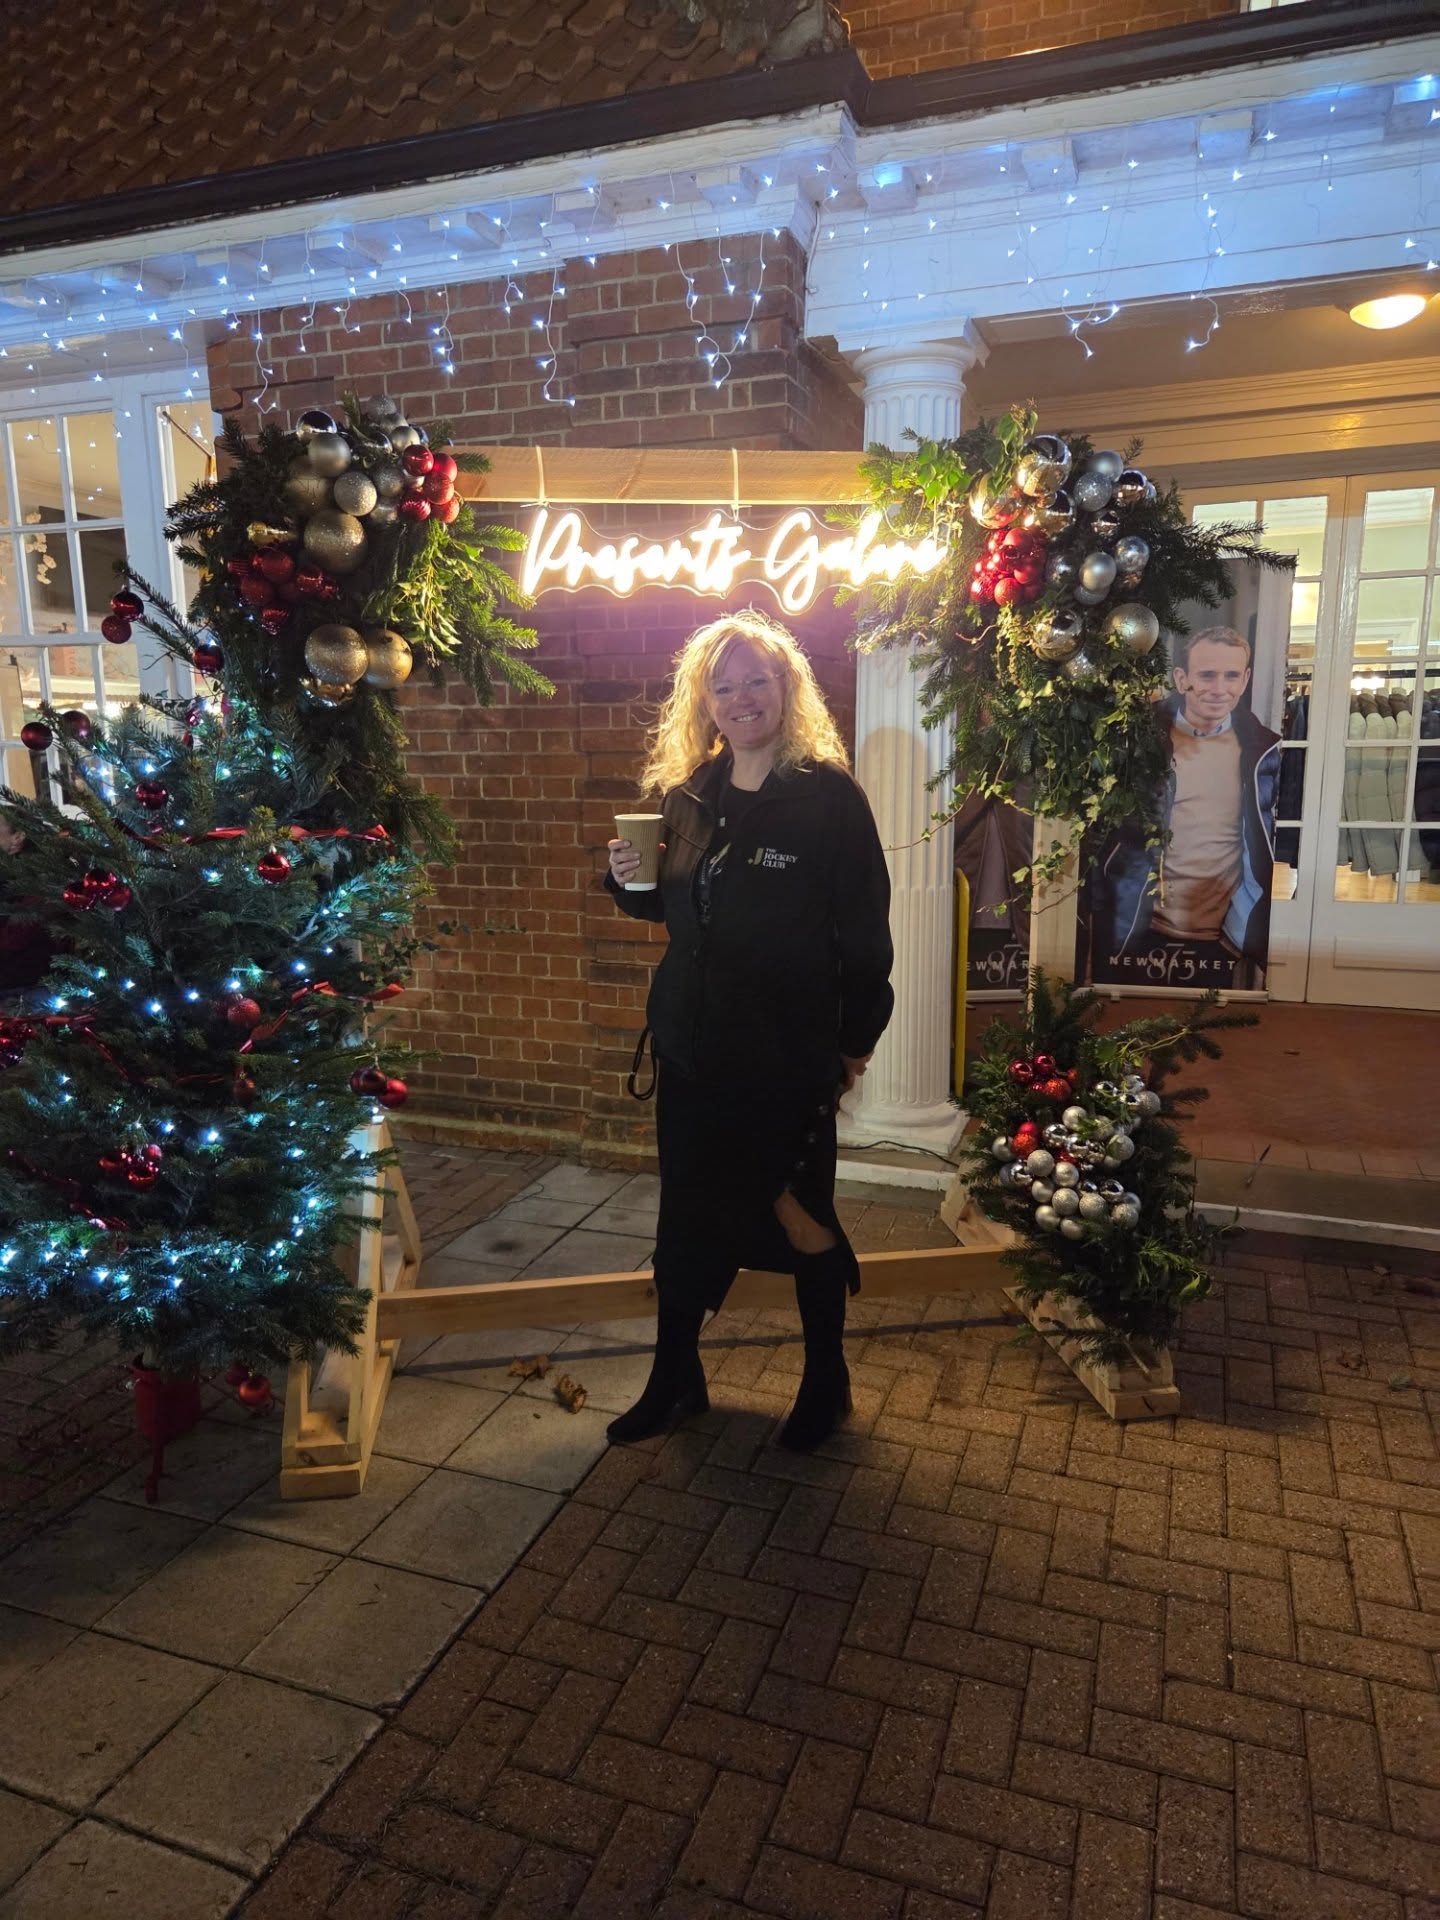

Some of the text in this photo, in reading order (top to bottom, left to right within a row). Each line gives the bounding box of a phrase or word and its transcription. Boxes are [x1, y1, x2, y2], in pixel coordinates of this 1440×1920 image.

[523, 509, 750, 596] Presents
[764, 852, 798, 863] JOCKEY
[762, 860, 786, 869] CLUB
[1109, 956, 1236, 970] NEWMARKET
